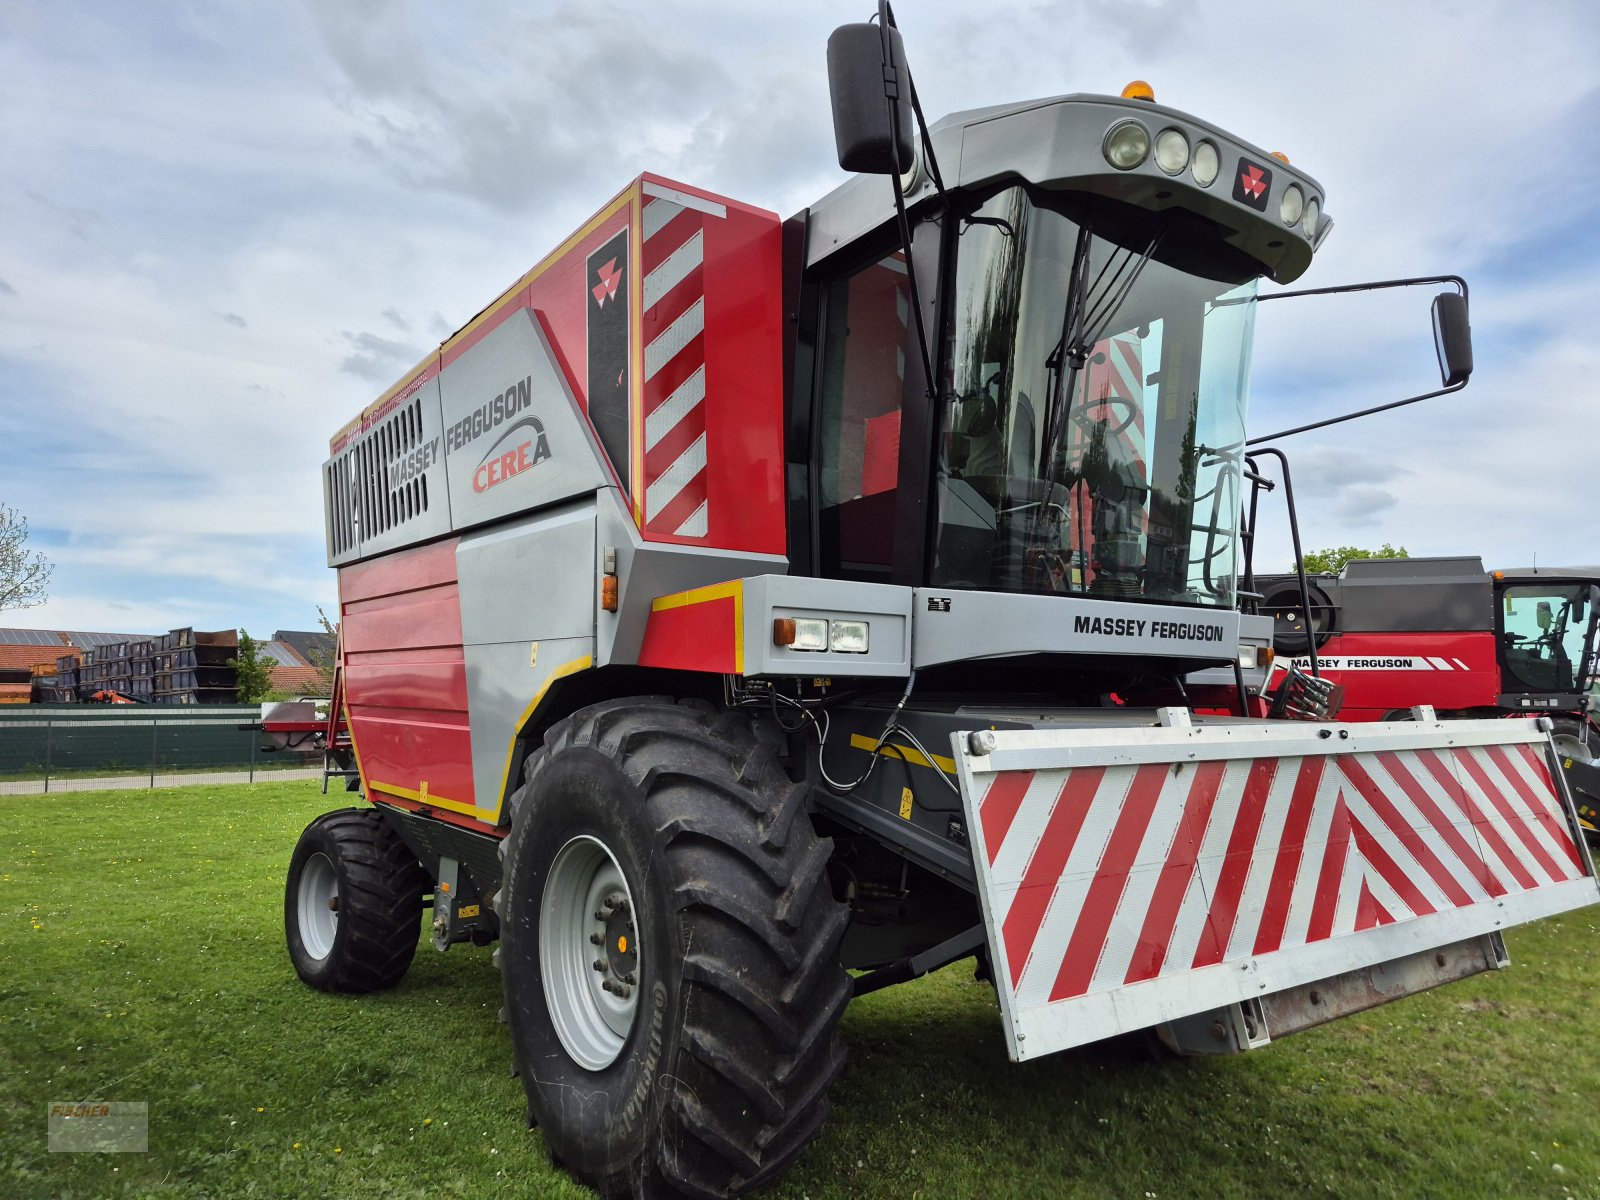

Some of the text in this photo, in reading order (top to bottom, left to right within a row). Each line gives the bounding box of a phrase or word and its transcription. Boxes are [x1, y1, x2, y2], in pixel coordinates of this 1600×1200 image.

[391, 375, 532, 490] MASSEY FERGUSON
[472, 433, 552, 494] CEREA
[1074, 615, 1224, 642] MASSEY FERGUSON
[1290, 659, 1413, 668] MASEY FERGUSON
